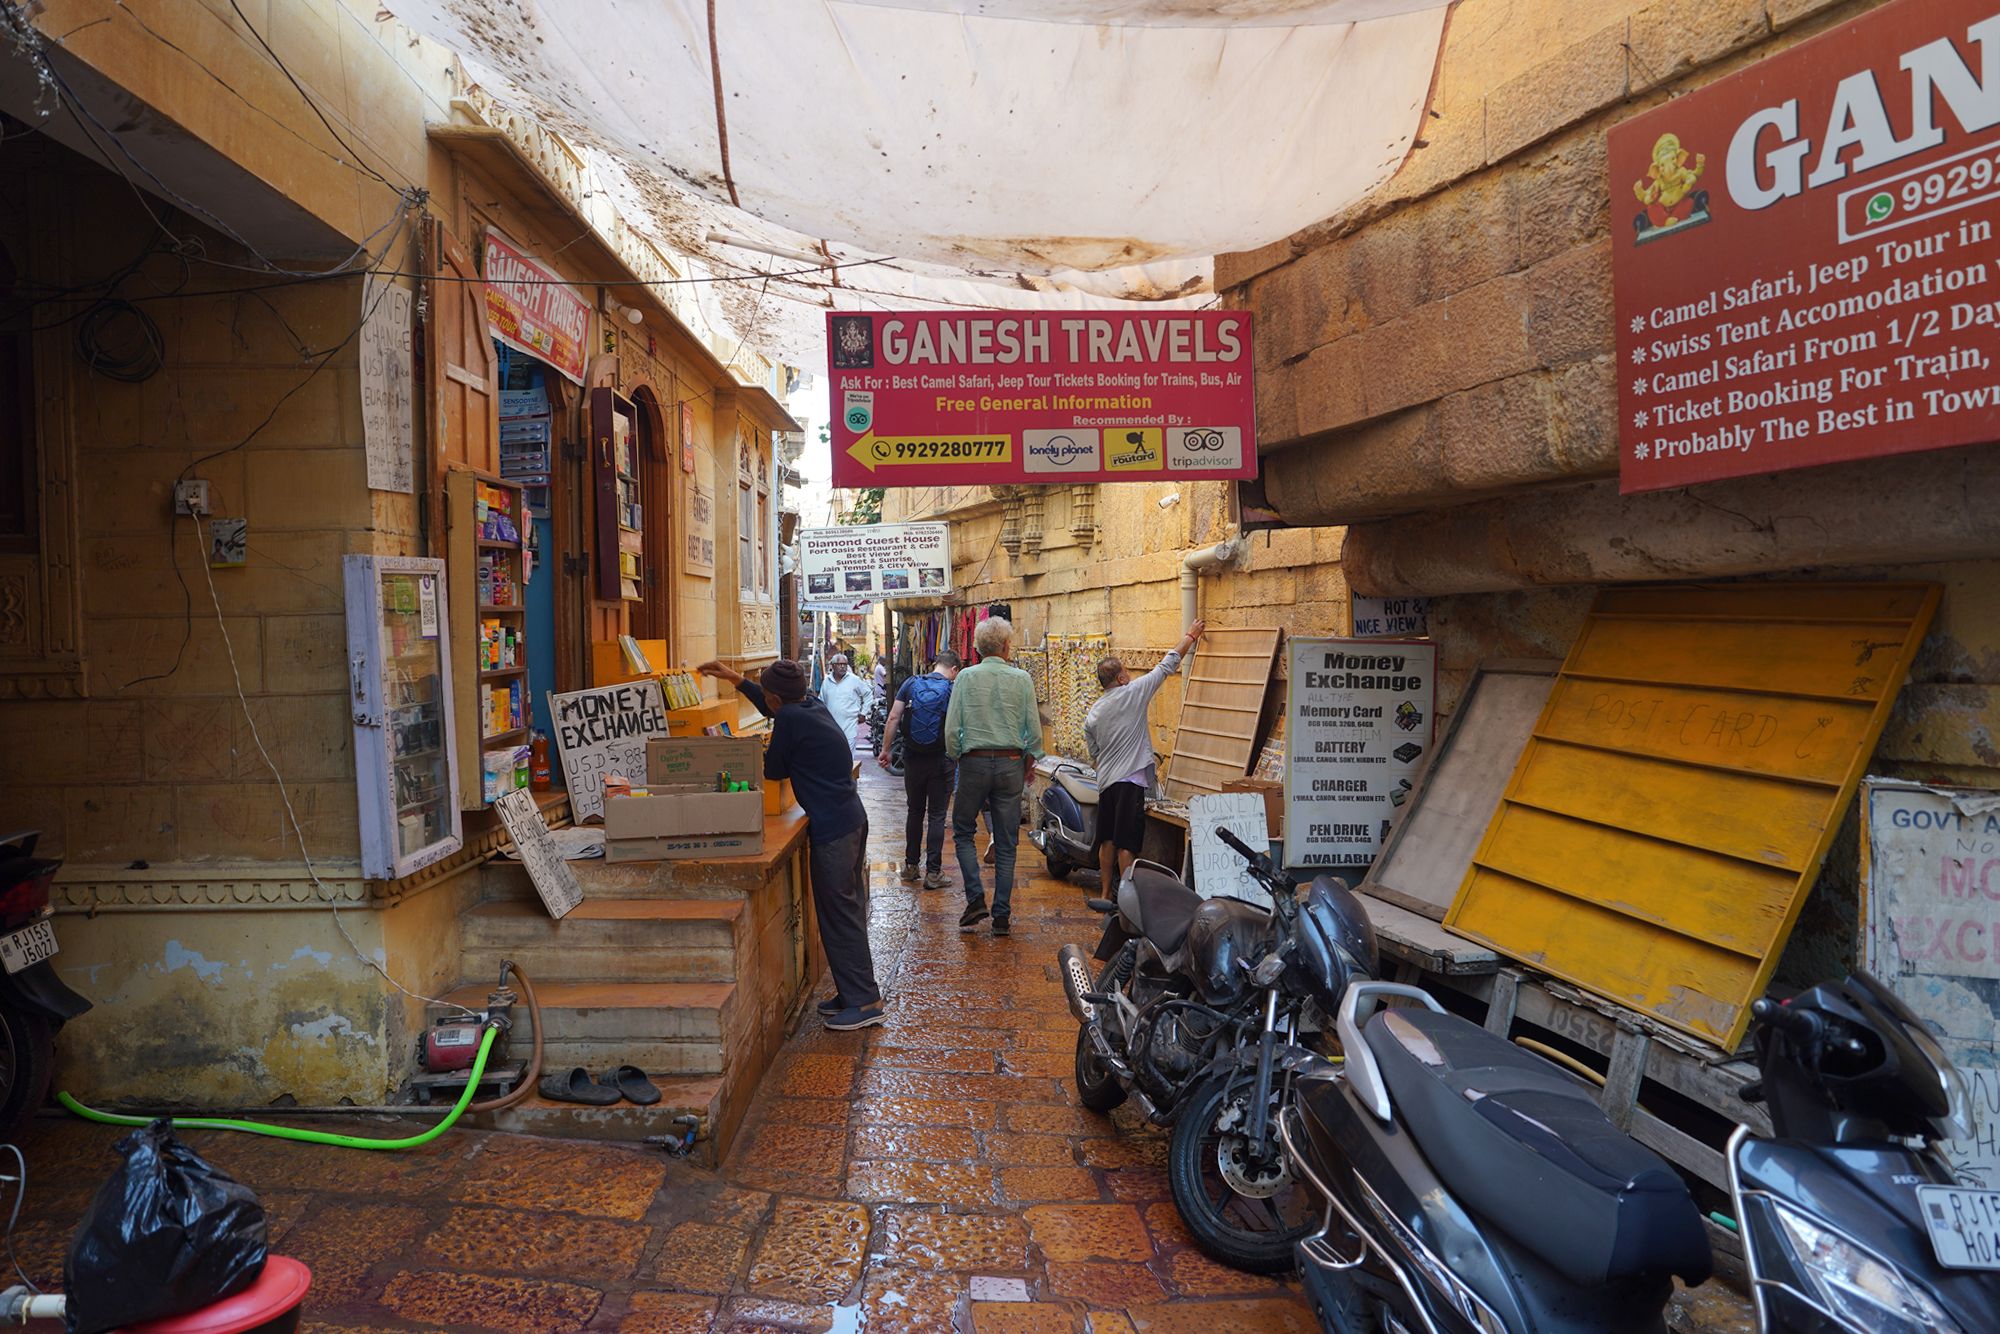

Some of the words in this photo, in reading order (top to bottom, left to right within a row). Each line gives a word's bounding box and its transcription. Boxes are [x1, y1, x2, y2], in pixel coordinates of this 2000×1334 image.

[1650, 291, 1717, 330] Camel
[1722, 270, 1802, 311] Safari,
[1808, 254, 1869, 293] Jeep
[1875, 229, 1950, 268] Tour
[1959, 219, 1991, 247] in
[486, 244, 543, 313] GANESH
[544, 282, 584, 343] TRAVELS
[1650, 334, 1711, 363] Swiss
[1716, 316, 1770, 346] Tent
[1775, 262, 1987, 332] Accomodation
[882, 319, 1049, 365] GANESH
[1061, 319, 1241, 363] TRAVELS
[1652, 361, 1719, 395] Camel
[1725, 344, 1797, 380] Safari
[1803, 329, 1877, 363] From
[1885, 310, 1941, 348] 1/2
[840, 375, 860, 390] Ask
[864, 375, 882, 390] For
[892, 375, 918, 390] Best
[921, 374, 955, 390] Camel
[958, 374, 995, 391] Safari,
[997, 374, 1024, 391] Jeep
[1026, 374, 1051, 388] Tour
[1054, 373, 1094, 387] Tickets
[1097, 373, 1140, 389] Booking
[1143, 372, 1159, 386] for
[1161, 372, 1197, 388] Trains,
[1200, 372, 1224, 388] Bus,
[1226, 371, 1241, 386] Air
[1652, 396, 1722, 428] Ticket
[1728, 377, 1833, 415] Booking
[1839, 366, 1888, 393] For
[1894, 345, 1990, 383] Train,
[936, 396, 975, 412] Free
[980, 395, 1048, 411] General
[1053, 395, 1152, 410] Information
[1073, 415, 1164, 426] Recommended
[1168, 415, 1183, 426] By
[1653, 424, 1755, 460] Probably
[1761, 415, 1810, 444] The
[1817, 403, 1878, 435] Best
[1885, 399, 1915, 422] in
[896, 441, 1005, 458] 9929280777
[1029, 445, 1060, 458] lonely
[1061, 445, 1093, 458] planet
[1112, 452, 1155, 466] routard
[1172, 455, 1234, 468] tripadvisor
[808, 539, 862, 548] Diamond
[865, 536, 900, 545] Guest
[904, 535, 940, 543] House
[857, 544, 907, 552] Restaurant
[843, 564, 875, 572] Temple
[887, 562, 905, 570] City
[1384, 600, 1409, 616] HOT
[1355, 619, 1381, 634] NICE
[1386, 617, 1417, 632] VIEW
[1324, 652, 1406, 672] Money
[1305, 672, 1421, 692] Exchange
[561, 686, 647, 722] MONEY
[1300, 704, 1351, 719] Memory
[1352, 705, 1383, 718] Card
[561, 707, 667, 750] EXCHANGE
[1314, 741, 1365, 754] BATTERY
[568, 753, 606, 776] USD
[1312, 779, 1367, 792] CHARGER
[576, 796, 604, 816] GB
[1310, 824, 1332, 837] PEN
[1335, 824, 1373, 837] DRIVE
